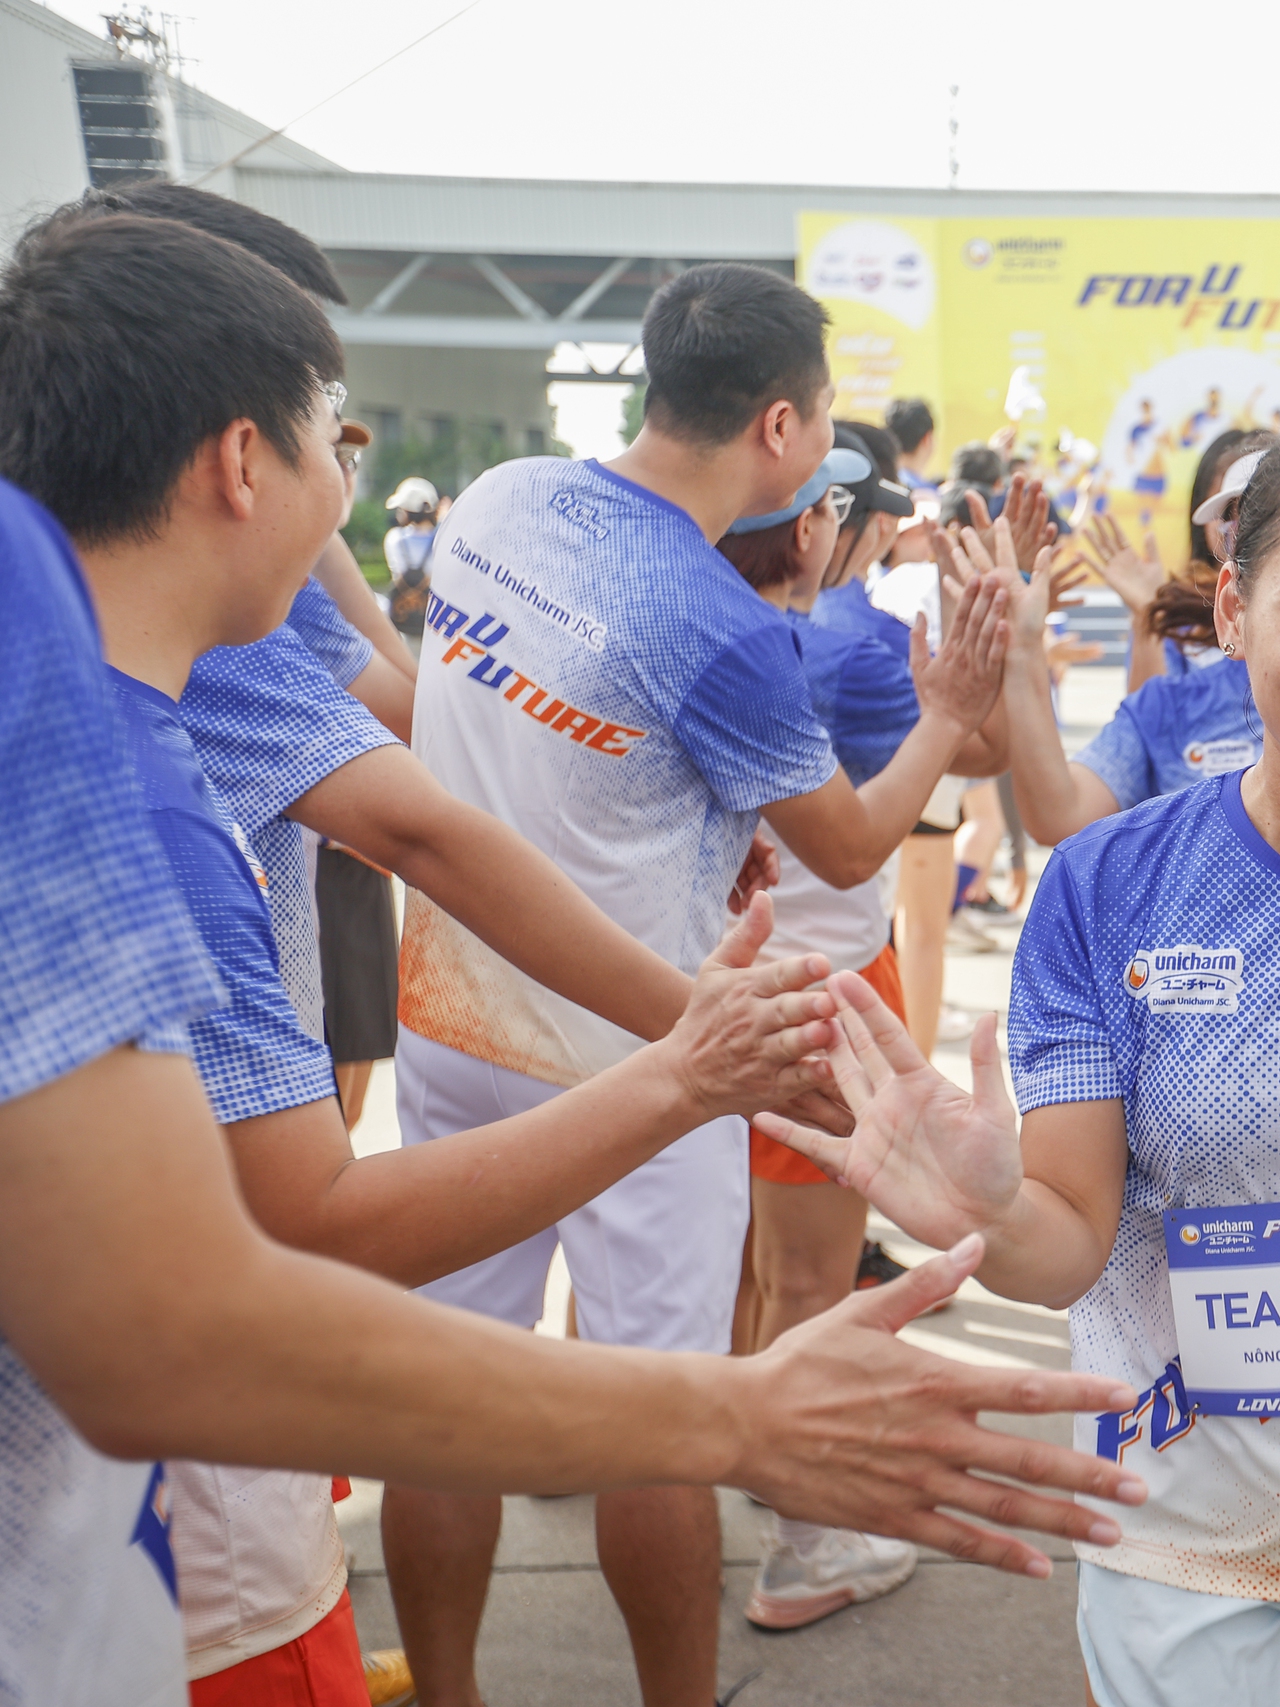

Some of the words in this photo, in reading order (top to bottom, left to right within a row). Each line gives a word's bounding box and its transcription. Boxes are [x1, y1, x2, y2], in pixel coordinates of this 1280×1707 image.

[1078, 273, 1195, 308] FOR
[1200, 262, 1243, 295] U
[451, 537, 491, 574] Diana
[494, 565, 571, 627] Unicharm
[427, 588, 470, 643] OR
[465, 611, 510, 647] U
[441, 637, 648, 758] FUTURE
[1155, 952, 1236, 970] unicharm
[1152, 998, 1175, 1006] Diana
[1177, 997, 1214, 1006] Unicharm
[1203, 1219, 1254, 1234] unicharm
